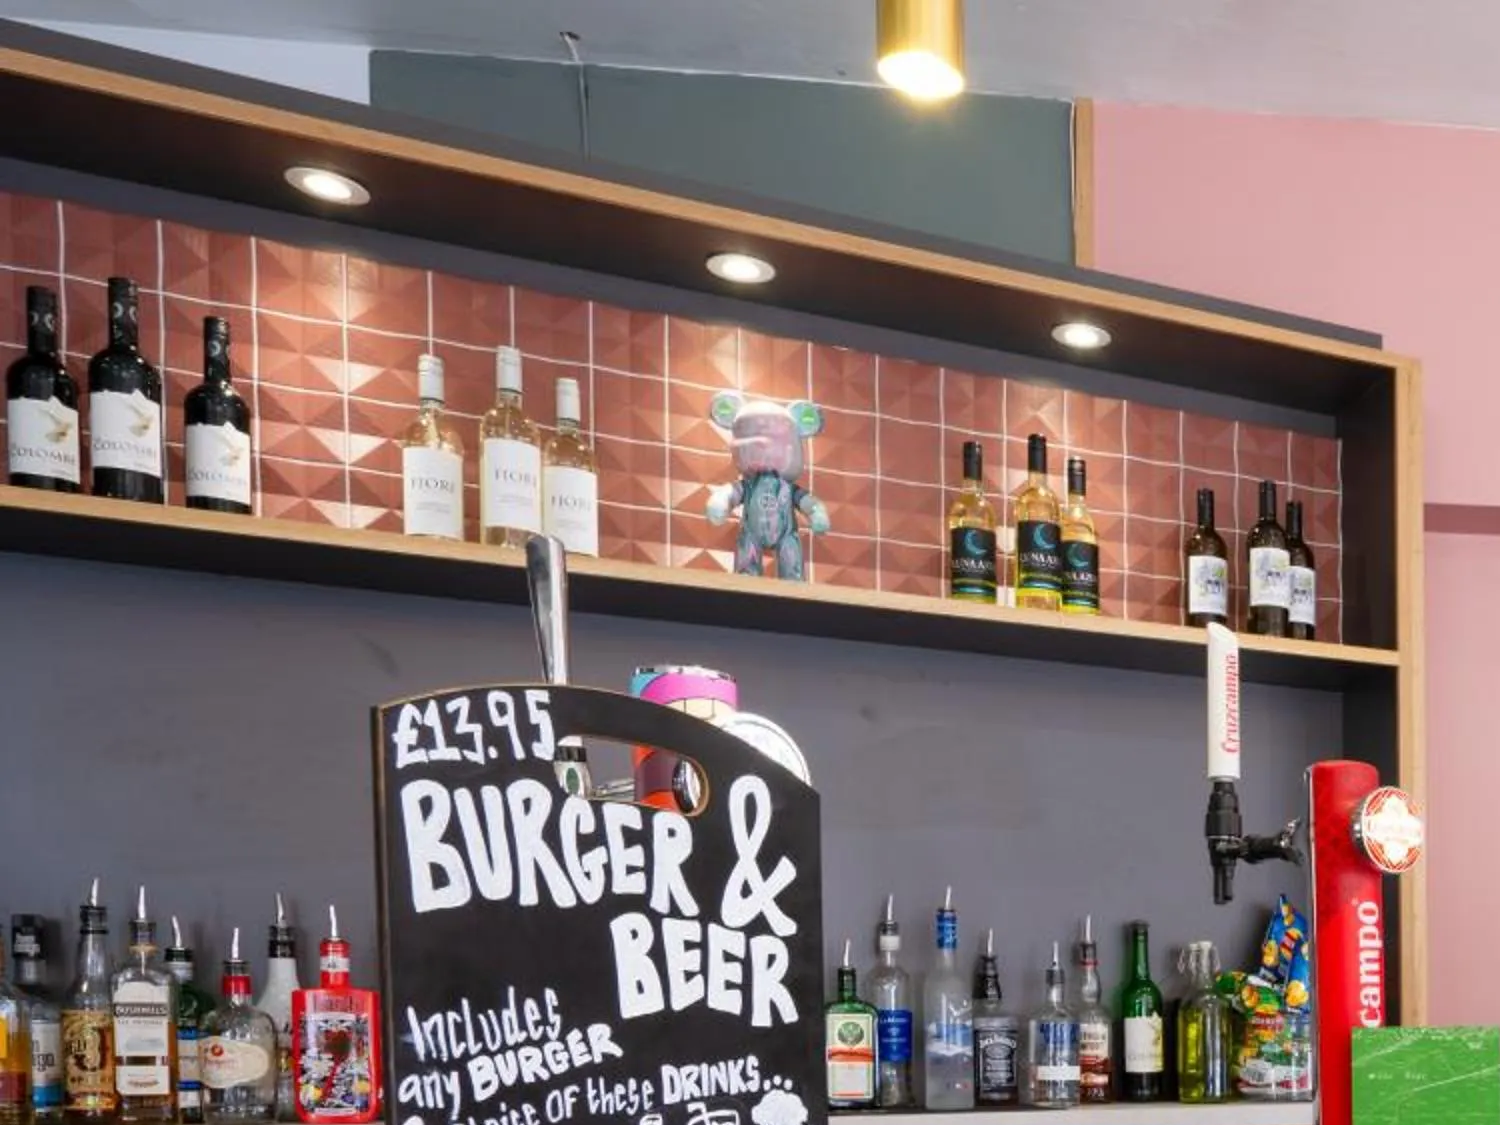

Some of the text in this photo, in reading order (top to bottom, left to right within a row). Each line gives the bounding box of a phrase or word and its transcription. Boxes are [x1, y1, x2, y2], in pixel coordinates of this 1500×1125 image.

[392, 690, 556, 768] £13.95
[400, 774, 798, 937] BURGER &
[609, 912, 799, 1028] BEER
[398, 1023, 624, 1121] any BURGER
[587, 1076, 656, 1117] these
